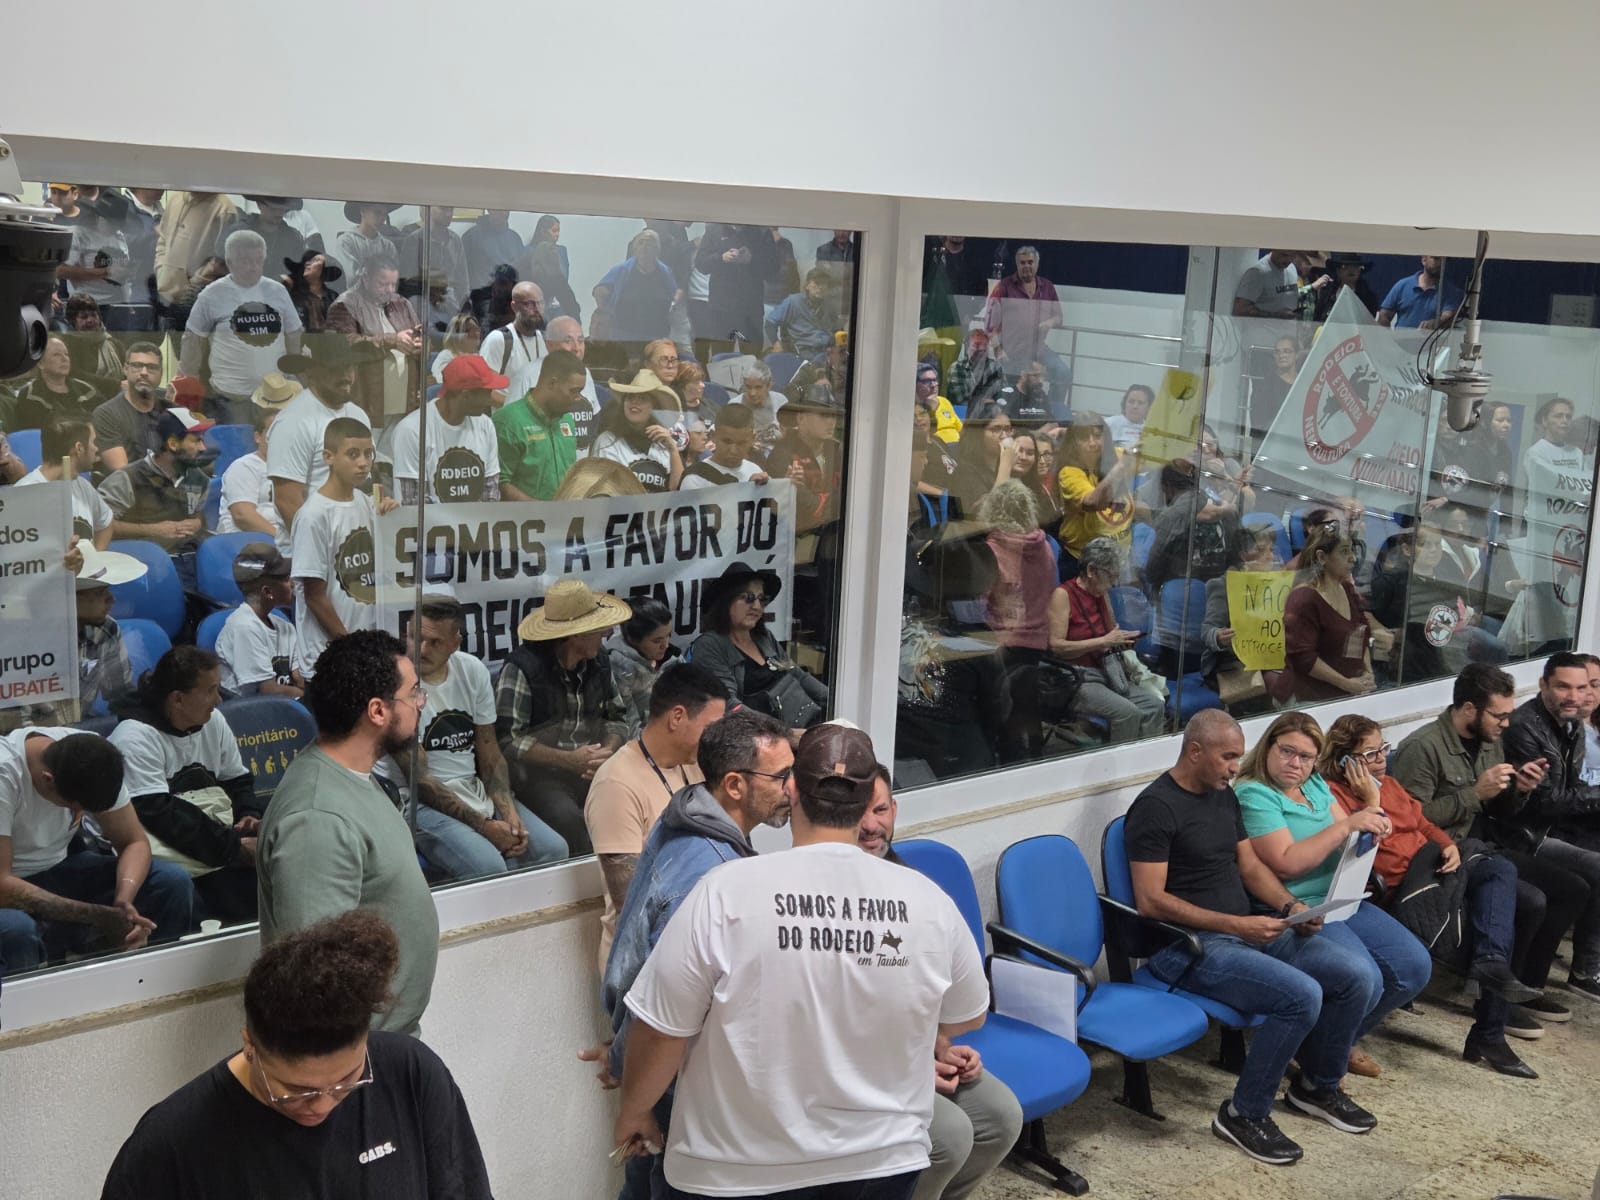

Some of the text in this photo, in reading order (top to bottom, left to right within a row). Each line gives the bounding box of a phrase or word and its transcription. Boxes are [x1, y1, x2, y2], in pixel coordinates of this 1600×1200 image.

[249, 326, 268, 336] SIM
[1313, 341, 1357, 394] RODEIO
[570, 411, 593, 422] DEIO
[441, 465, 480, 480] RODEIO
[450, 484, 469, 497] SIM
[395, 498, 778, 589] SOMOS A FAVOR DO
[1246, 578, 1292, 614] NÃO
[1261, 619, 1282, 638] AO
[0, 652, 55, 677] rupo
[234, 727, 298, 747] rioritário
[774, 893, 909, 924] SOMOS A FAVOR
[778, 925, 875, 954] DO RODEIO
[857, 957, 872, 966] em
[359, 1141, 396, 1164] GABS.
